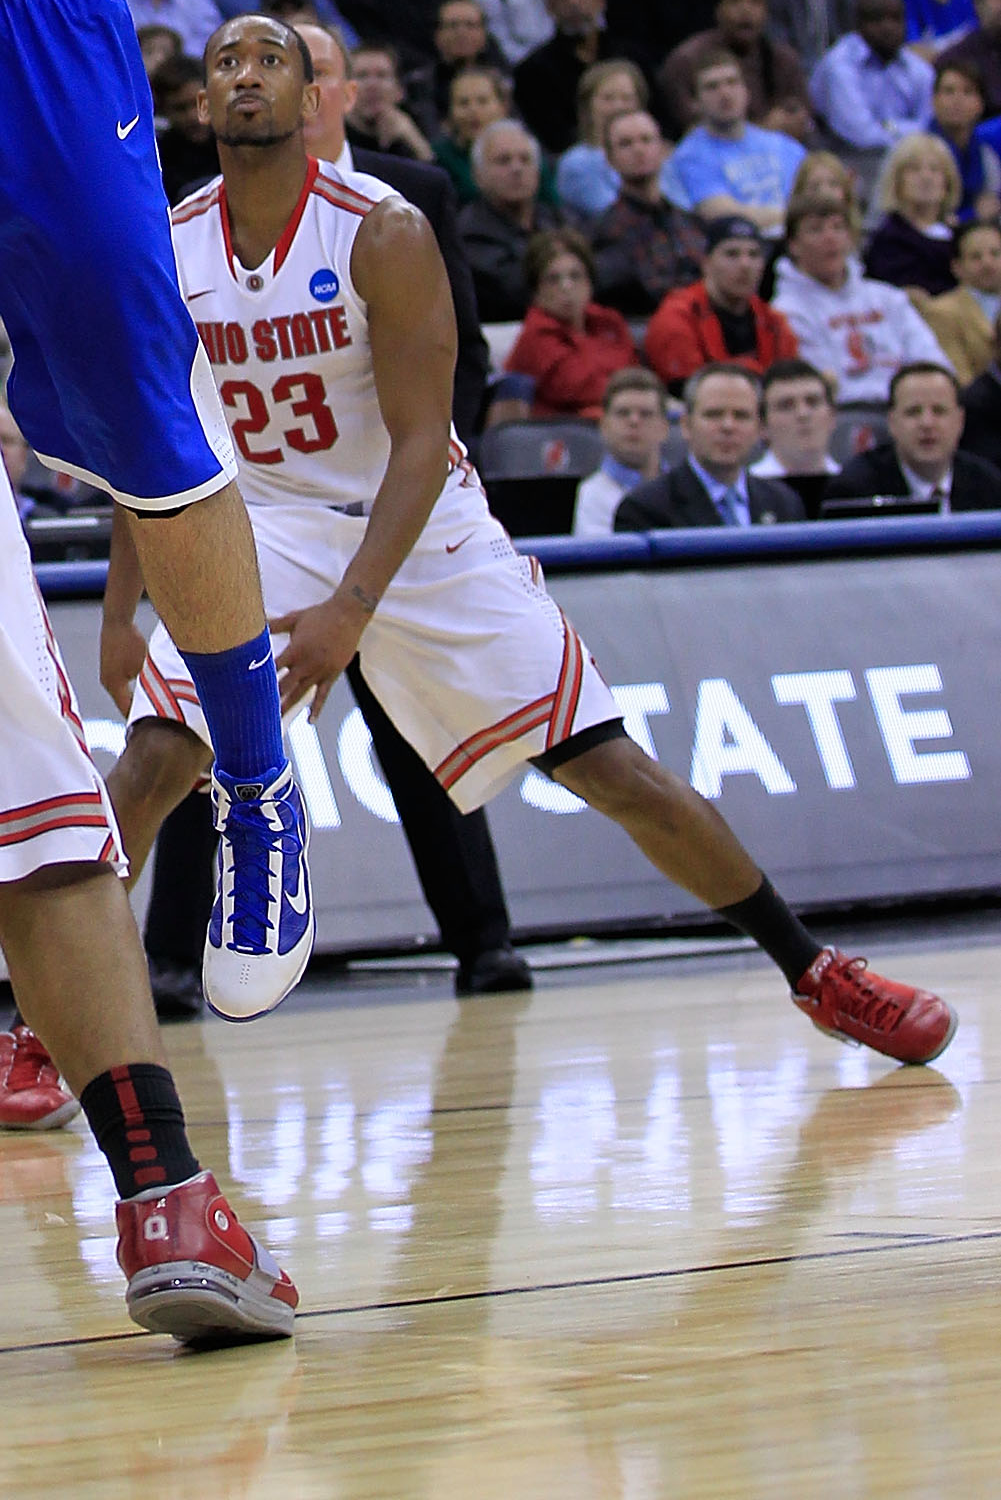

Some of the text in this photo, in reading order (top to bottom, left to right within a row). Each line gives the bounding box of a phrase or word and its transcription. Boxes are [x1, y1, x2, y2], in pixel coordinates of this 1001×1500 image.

[196, 305, 352, 365] HIO STATE
[220, 372, 339, 465] 23
